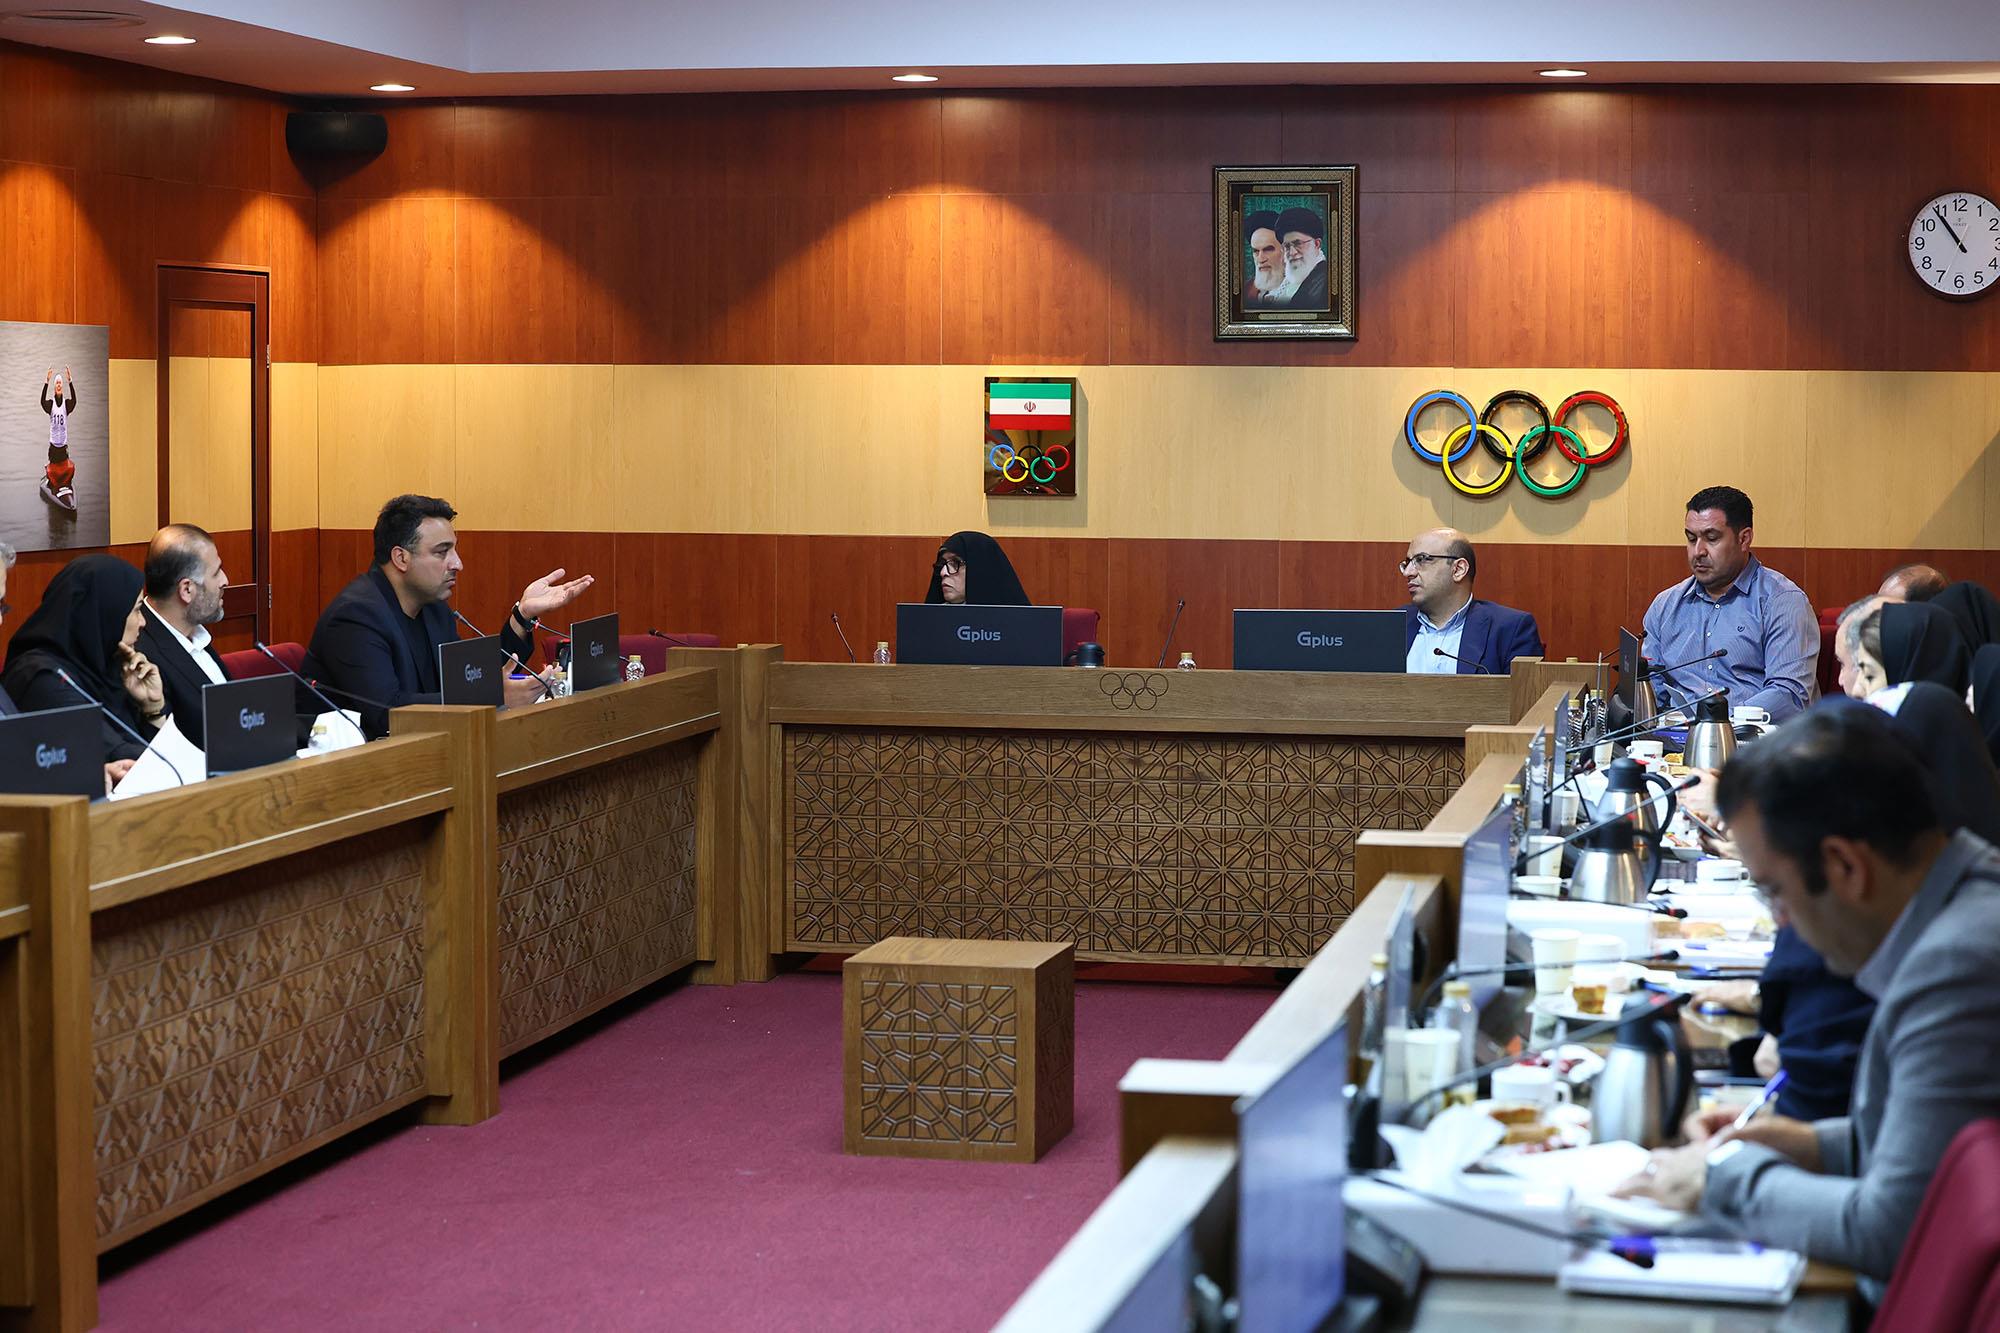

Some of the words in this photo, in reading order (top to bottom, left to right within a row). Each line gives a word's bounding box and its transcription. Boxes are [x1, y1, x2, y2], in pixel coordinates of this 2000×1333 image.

[1935, 204, 1947, 217] 11
[1952, 198, 1968, 212] 12
[1977, 204, 1982, 217] 1
[1920, 219, 1936, 232] 10
[1989, 218, 1999, 231] 2
[1914, 236, 1925, 250] 9
[1921, 256, 1932, 269] 8
[1988, 257, 1998, 270] 4
[1936, 270, 1946, 283] 7
[1953, 275, 1964, 288] 6
[1973, 271, 1984, 284] 5
[53, 414, 64, 426] 118
[957, 625, 1001, 643] Gplus
[1297, 631, 1343, 648] Gplus
